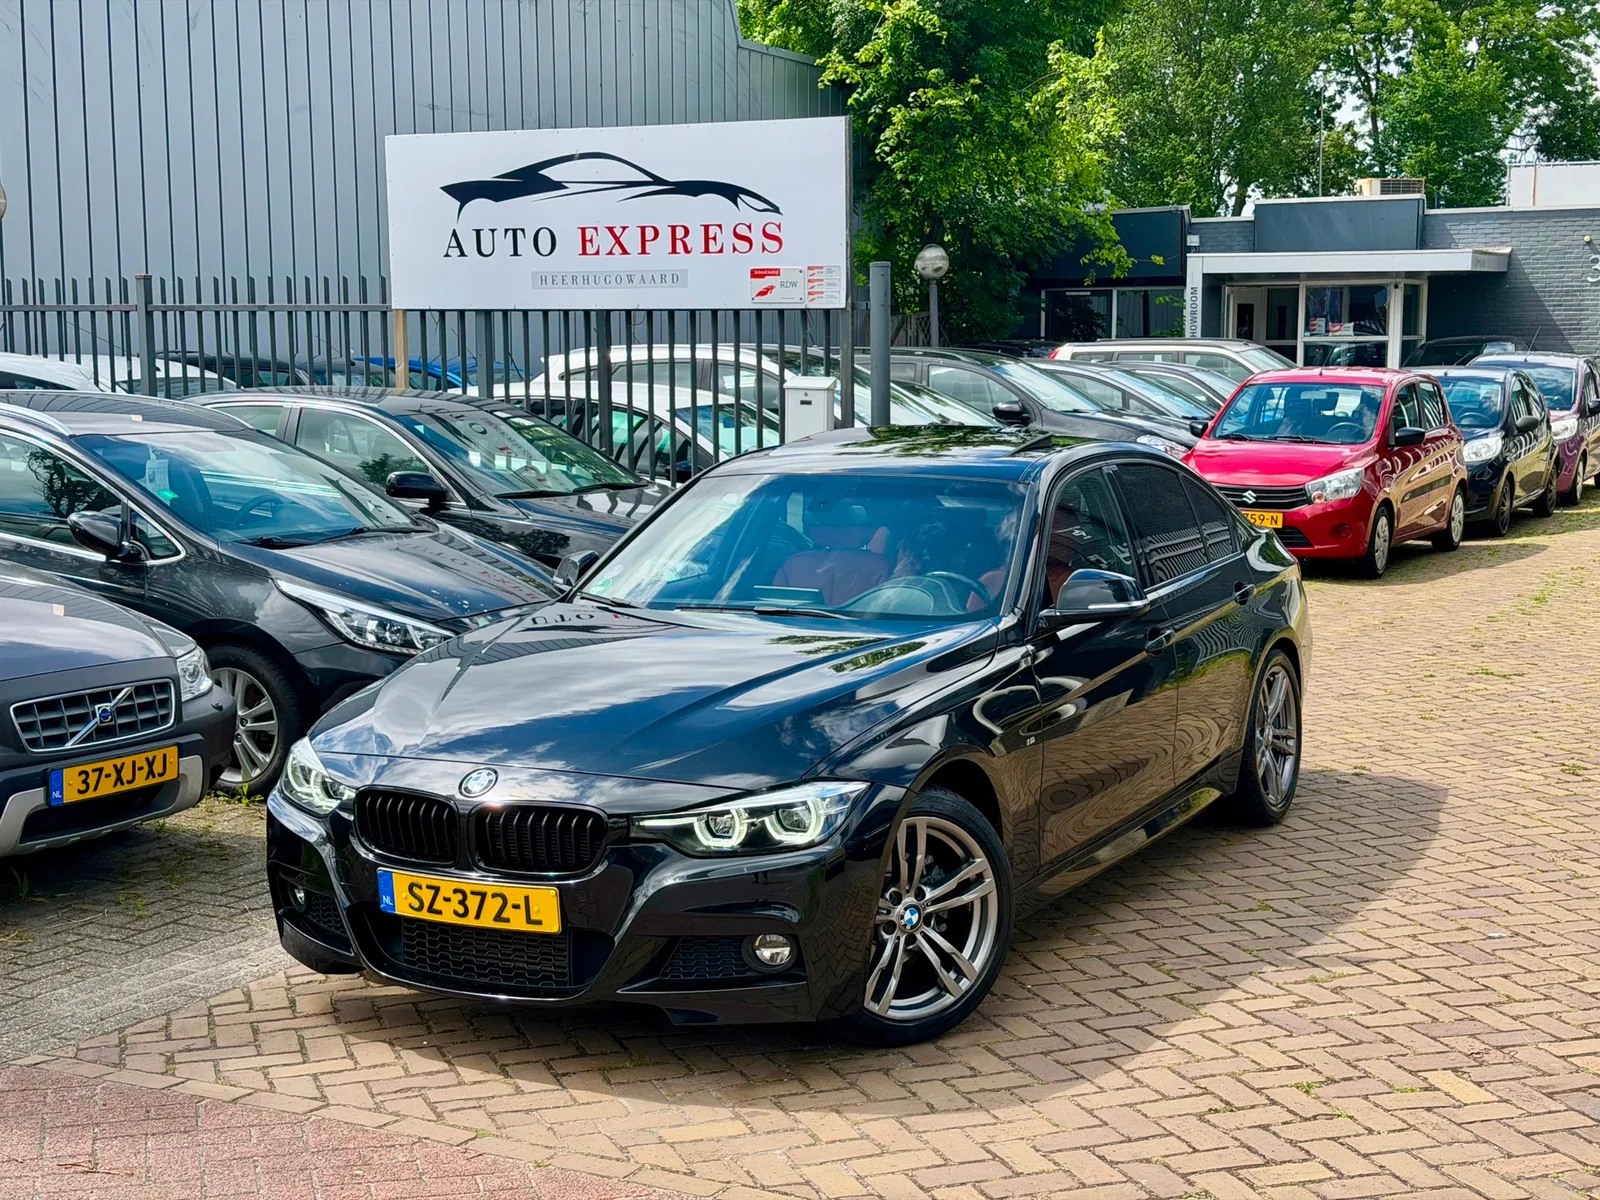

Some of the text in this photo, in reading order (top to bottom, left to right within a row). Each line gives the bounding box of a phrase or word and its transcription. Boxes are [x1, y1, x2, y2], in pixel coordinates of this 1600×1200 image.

[443, 221, 784, 258] AUTO EXPRESS
[539, 273, 680, 286] HEERHUGOWAARD
[780, 280, 799, 289] RDW
[1189, 286, 1199, 338] HOWROOM
[76, 752, 168, 795] 37-XJ-XJ
[52, 790, 62, 799] NL
[382, 895, 394, 906] NL
[407, 881, 543, 926] SZ-372-L
